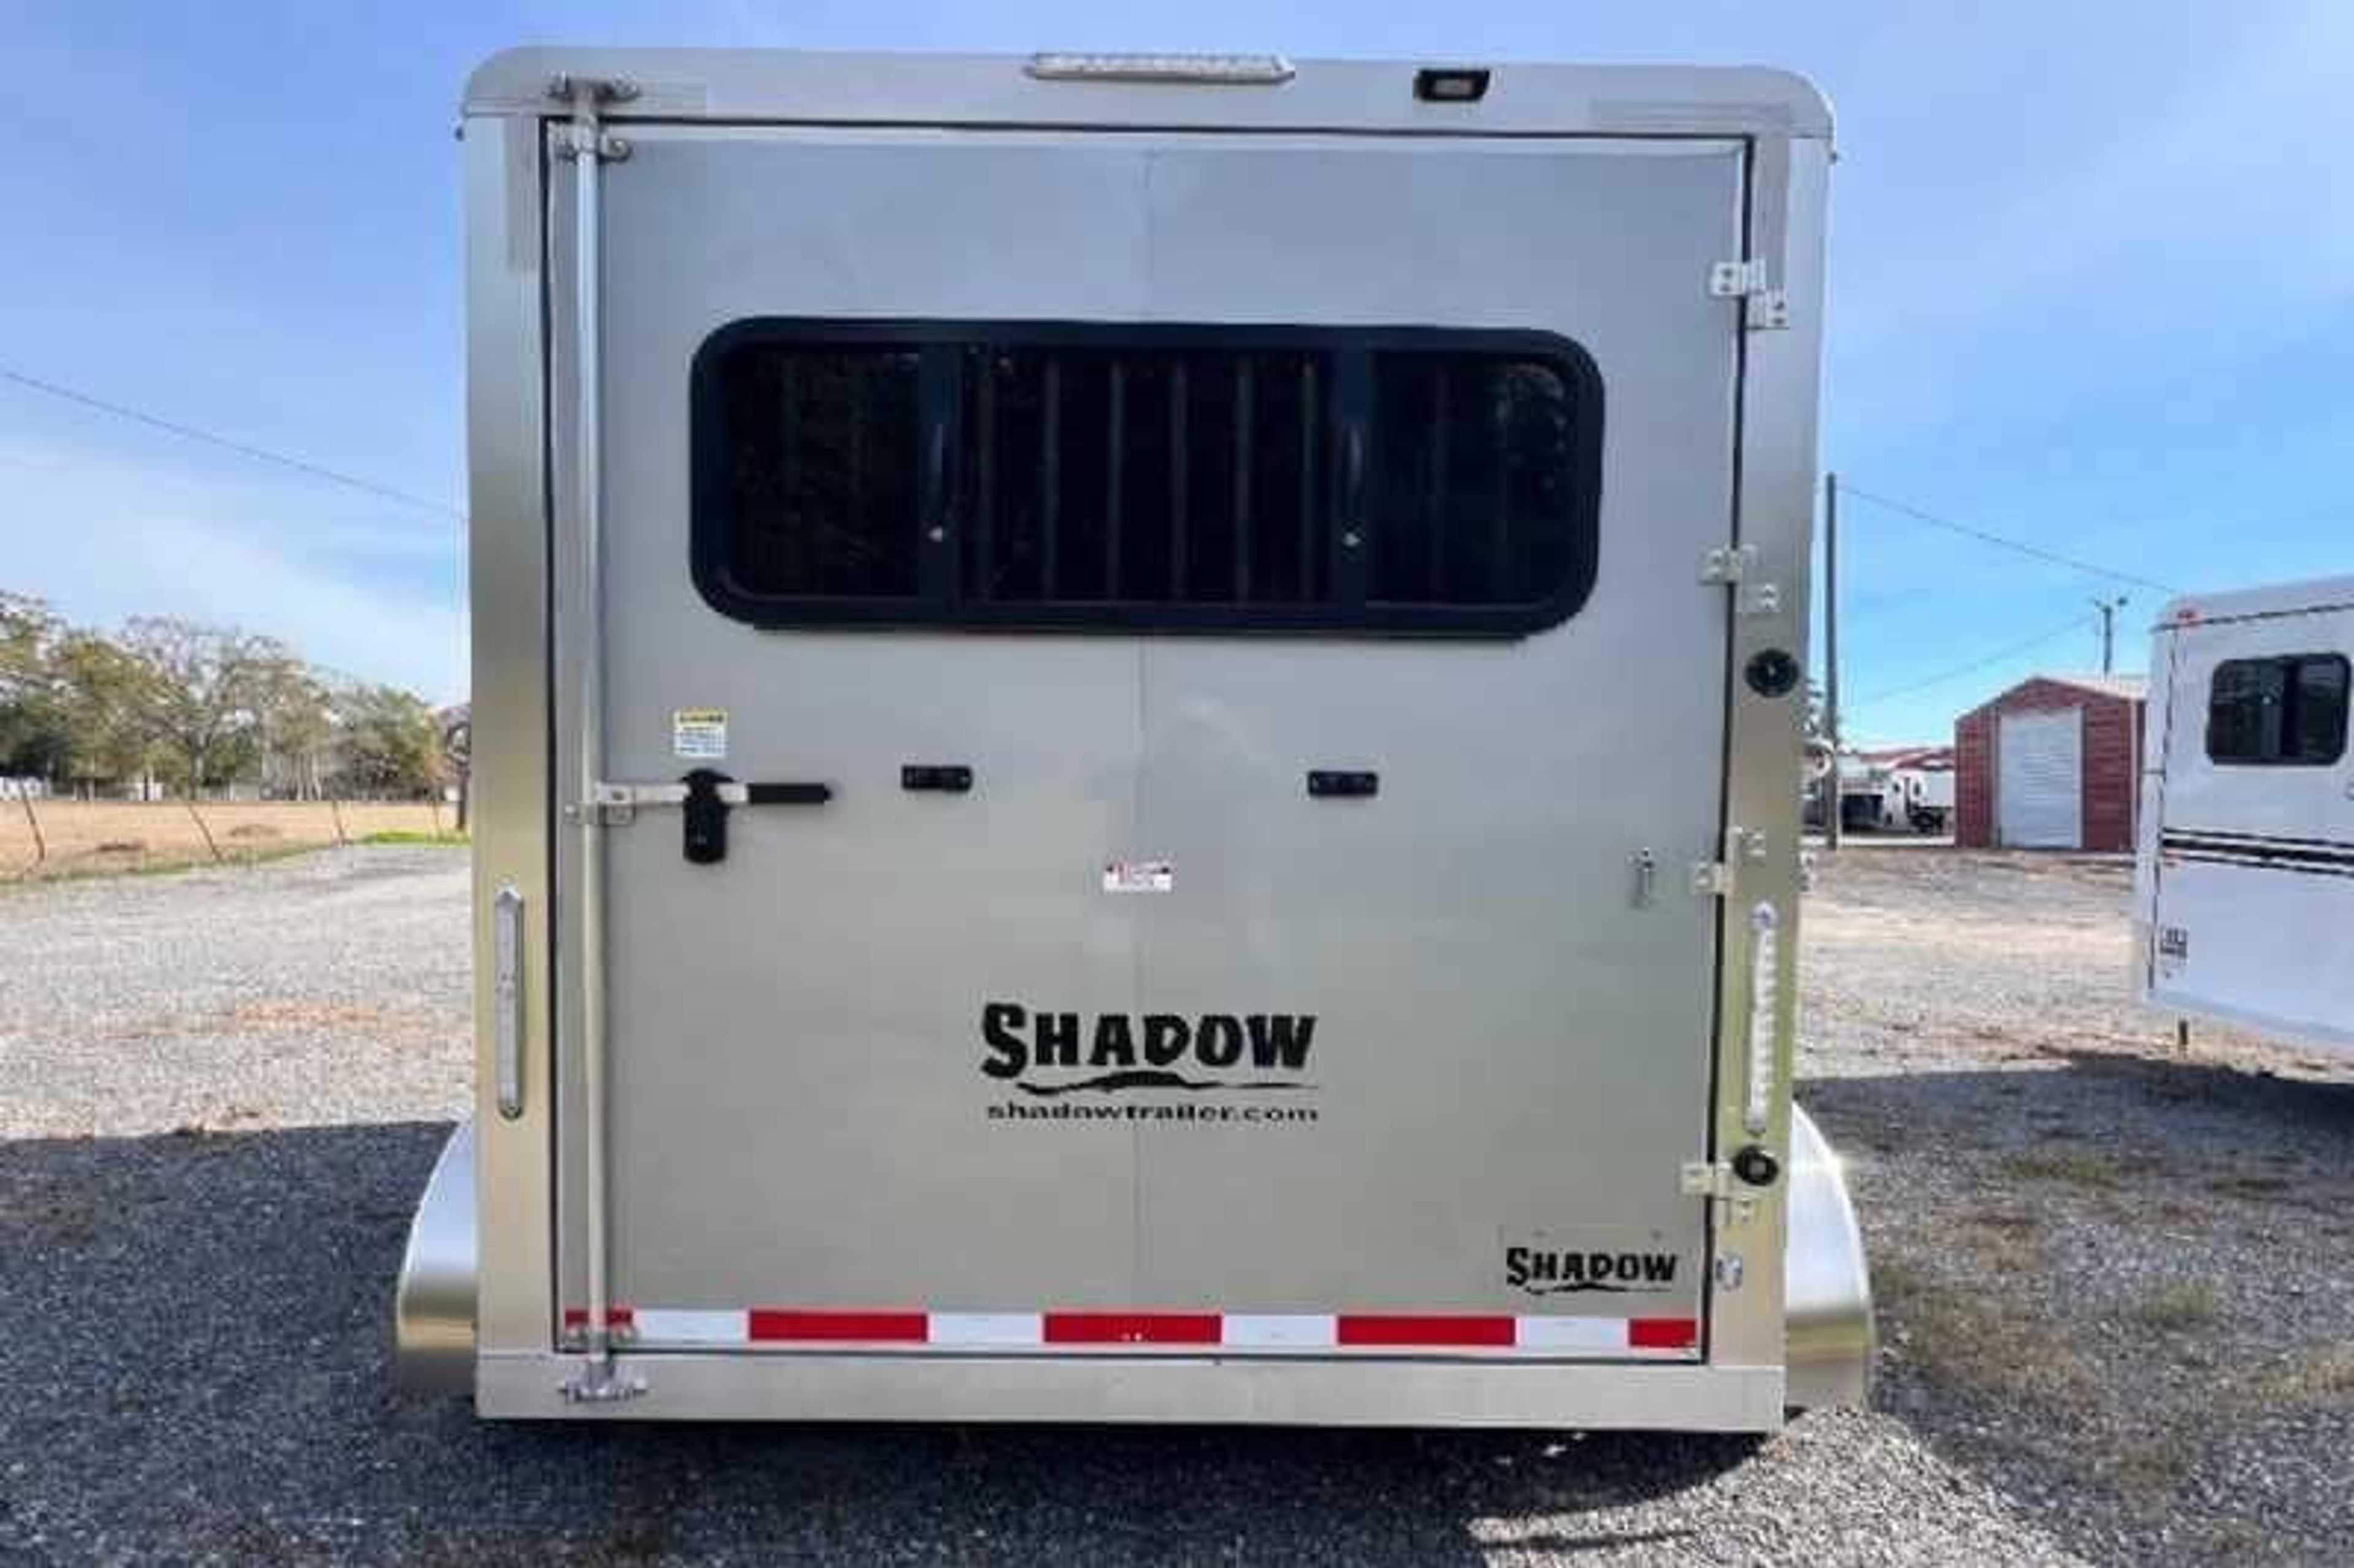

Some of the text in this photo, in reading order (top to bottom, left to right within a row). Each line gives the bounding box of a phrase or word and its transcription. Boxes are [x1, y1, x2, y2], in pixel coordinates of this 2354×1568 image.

[981, 1003, 1316, 1079] SHADOW
[988, 1102, 1318, 1122] shadowtrailer.com
[1506, 1247, 1677, 1286] SHADOW
